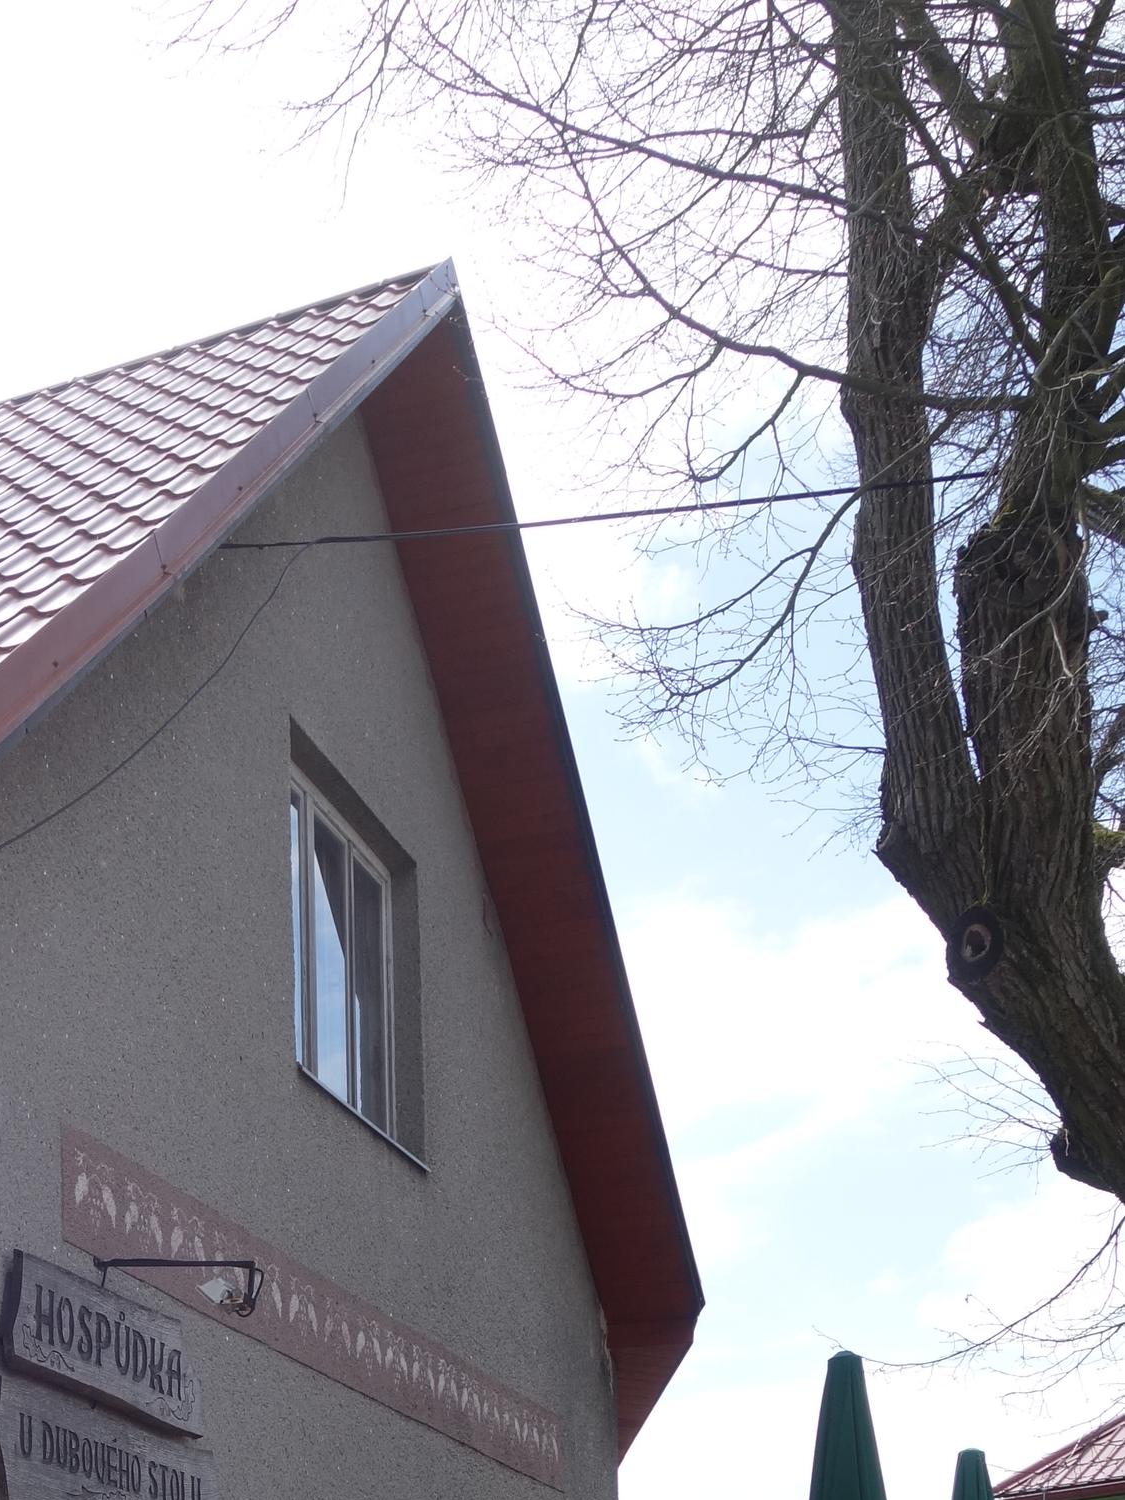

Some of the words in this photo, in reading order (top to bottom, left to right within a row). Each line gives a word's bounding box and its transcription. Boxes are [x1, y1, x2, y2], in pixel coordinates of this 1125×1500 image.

[34, 1283, 182, 1401] HOSPŮDKA
[19, 1412, 33, 1458] U
[41, 1420, 142, 1494] DUBOVÉHO
